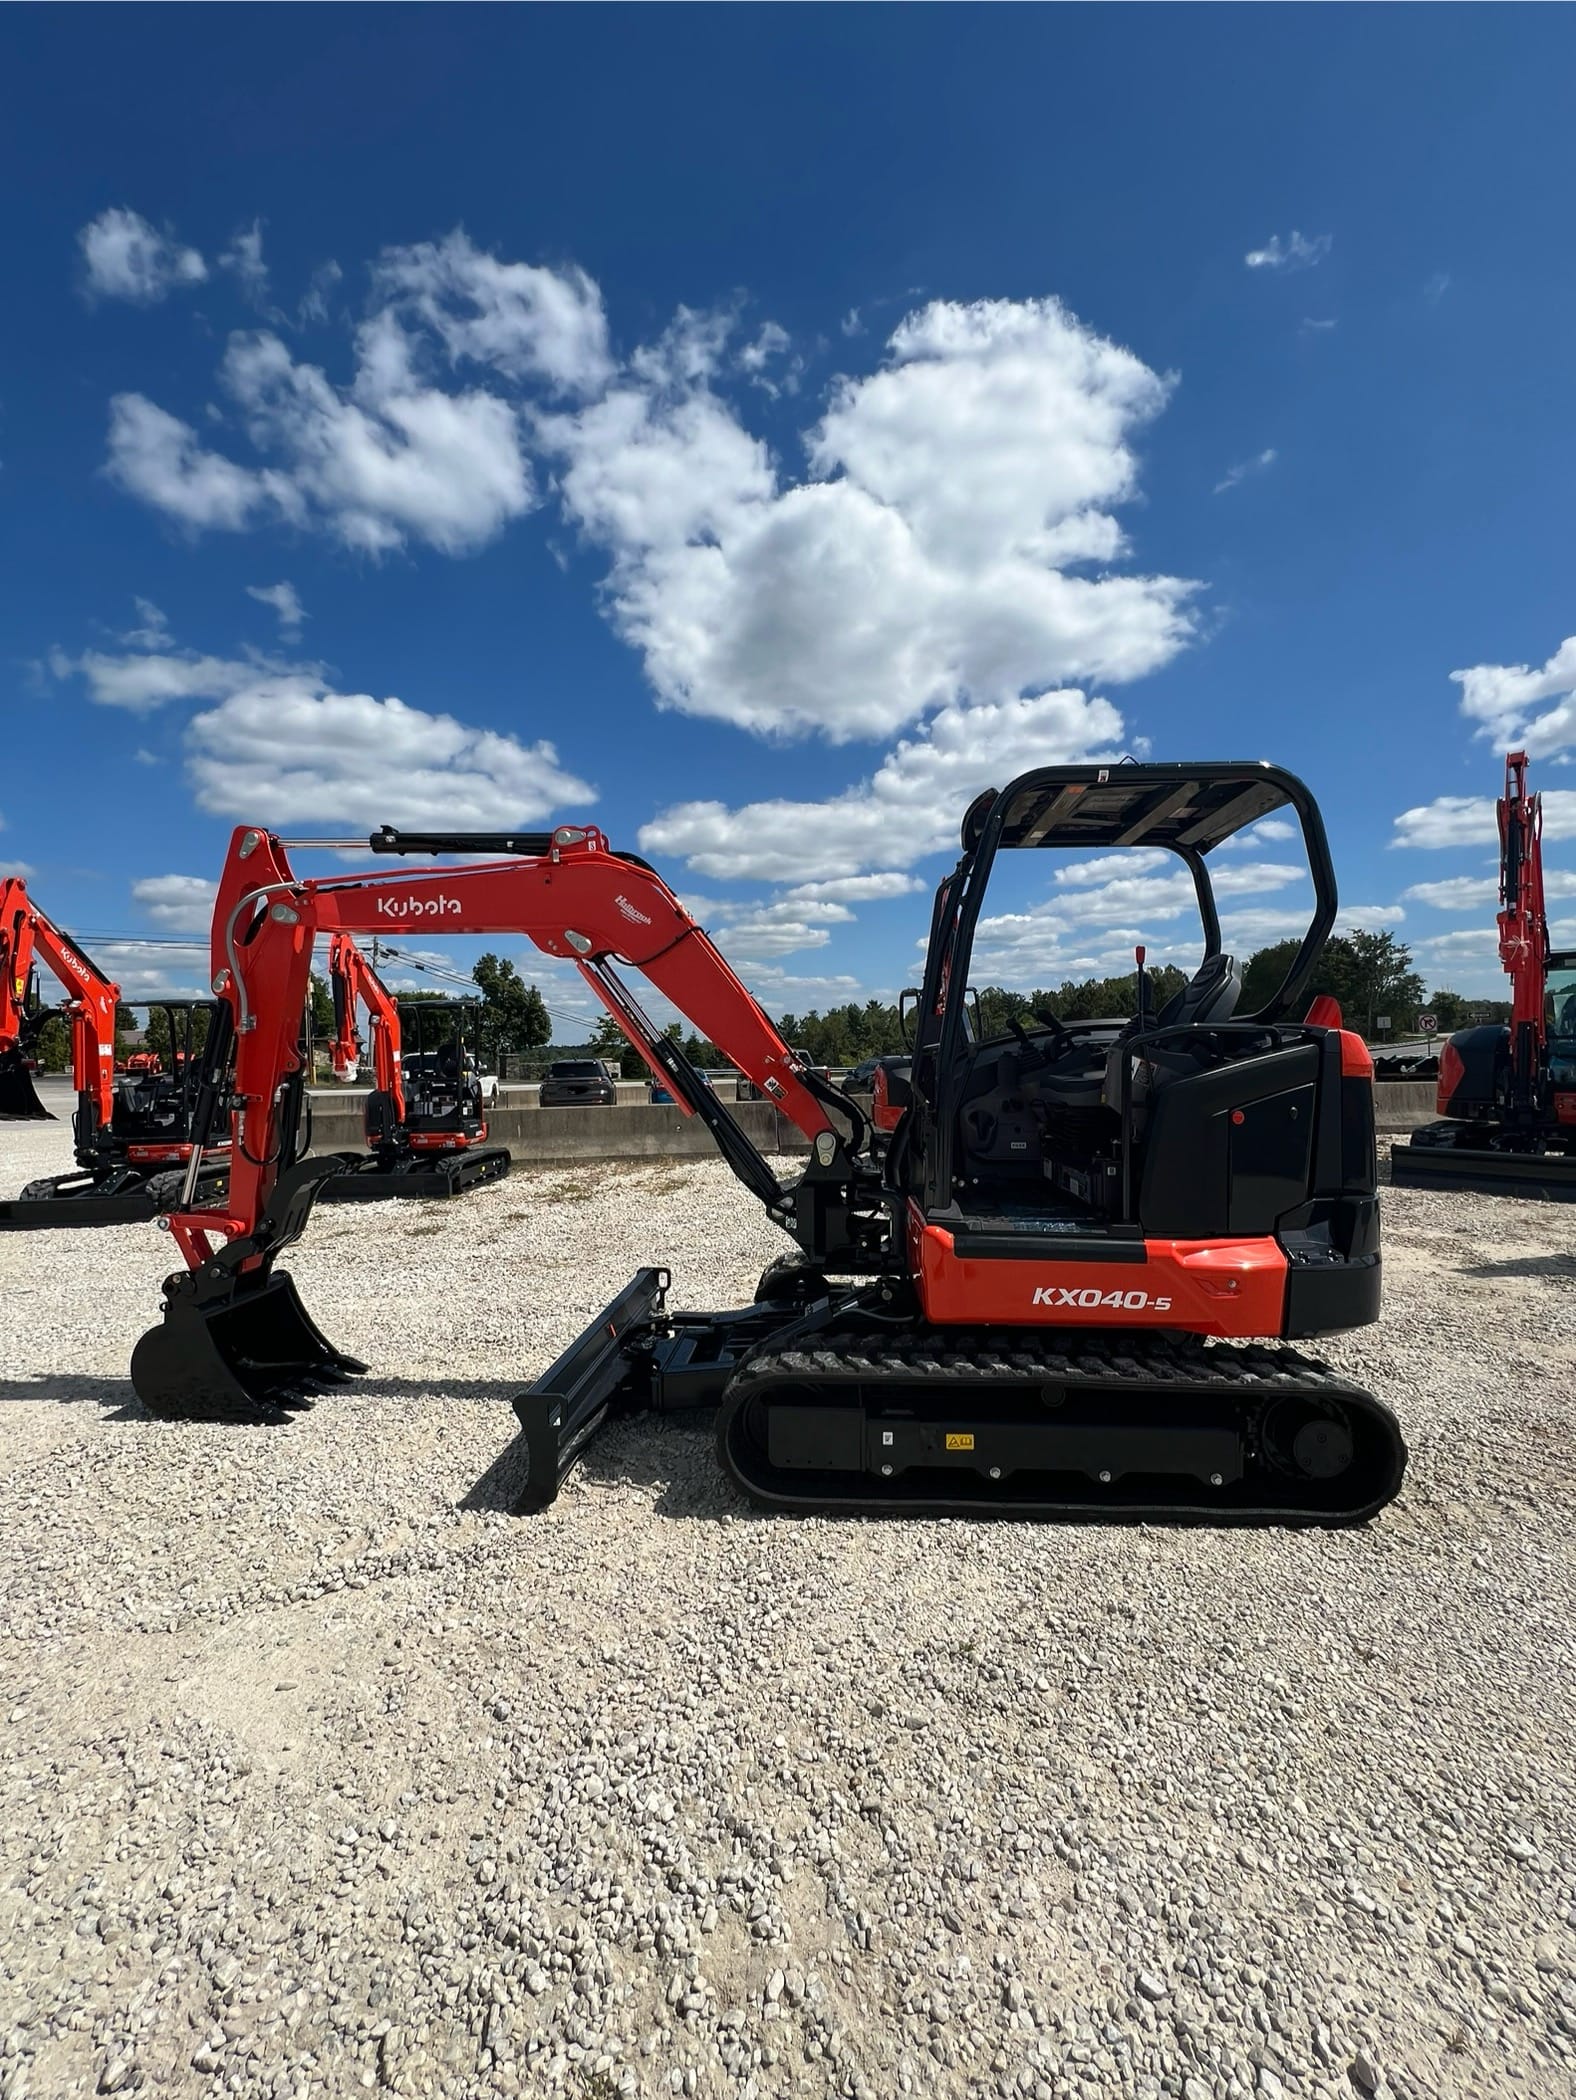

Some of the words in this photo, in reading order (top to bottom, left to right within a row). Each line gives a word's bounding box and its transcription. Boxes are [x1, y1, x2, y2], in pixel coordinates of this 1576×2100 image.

[378, 895, 462, 917] Kubota
[61, 947, 90, 982] Kubota
[1032, 1287, 1172, 1311] KX040-5
